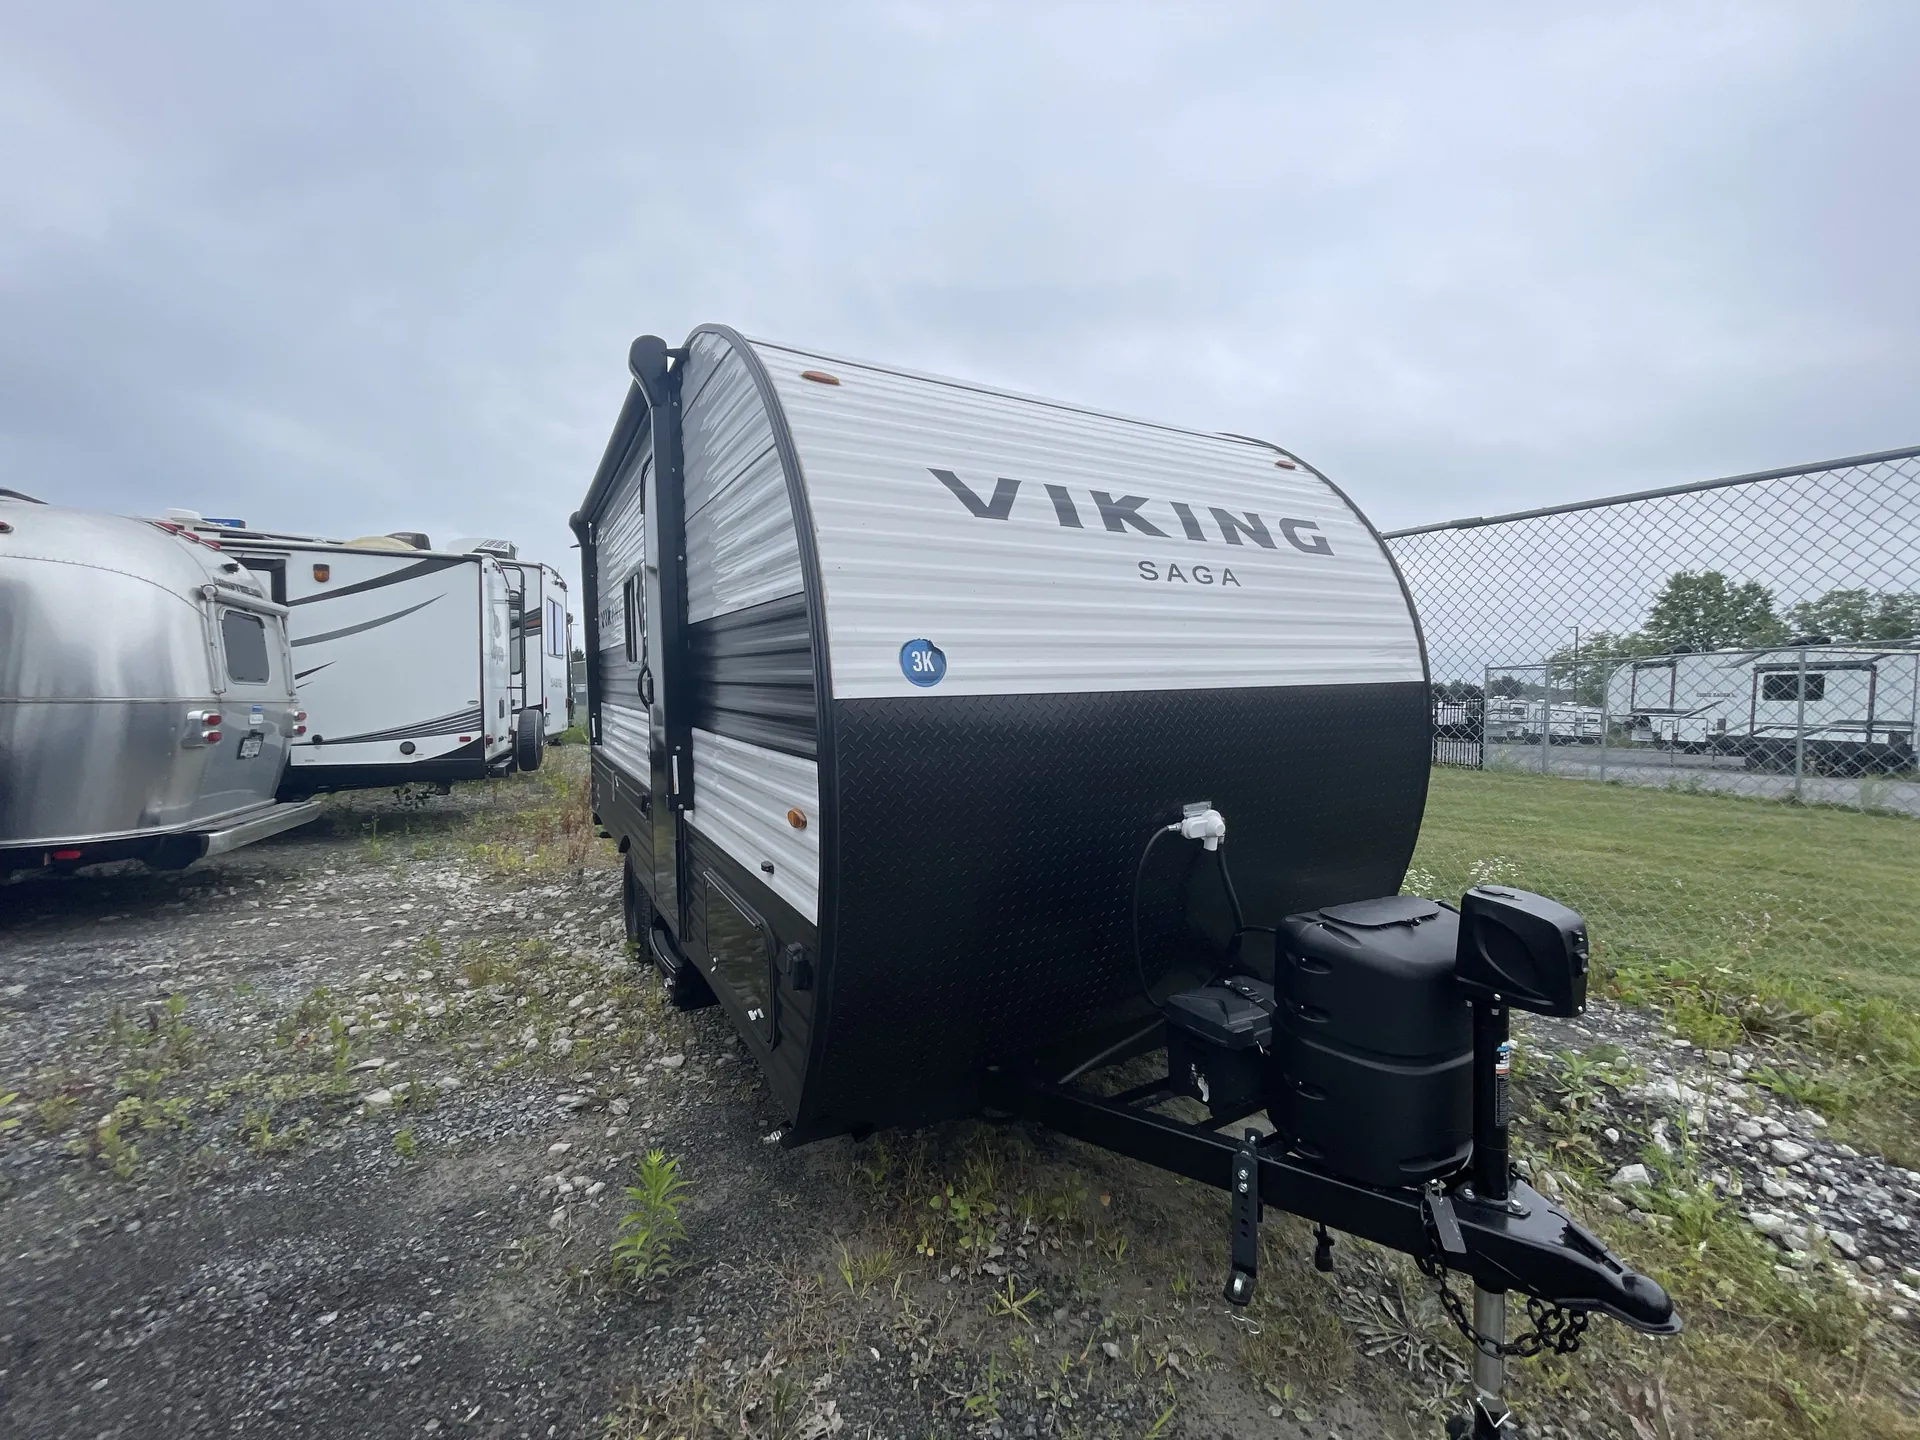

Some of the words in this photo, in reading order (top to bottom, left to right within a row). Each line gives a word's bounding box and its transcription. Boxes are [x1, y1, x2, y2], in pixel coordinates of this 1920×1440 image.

[926, 467, 1335, 557] VIKING
[1137, 560, 1242, 588] SAGA
[911, 650, 935, 672] 3K
